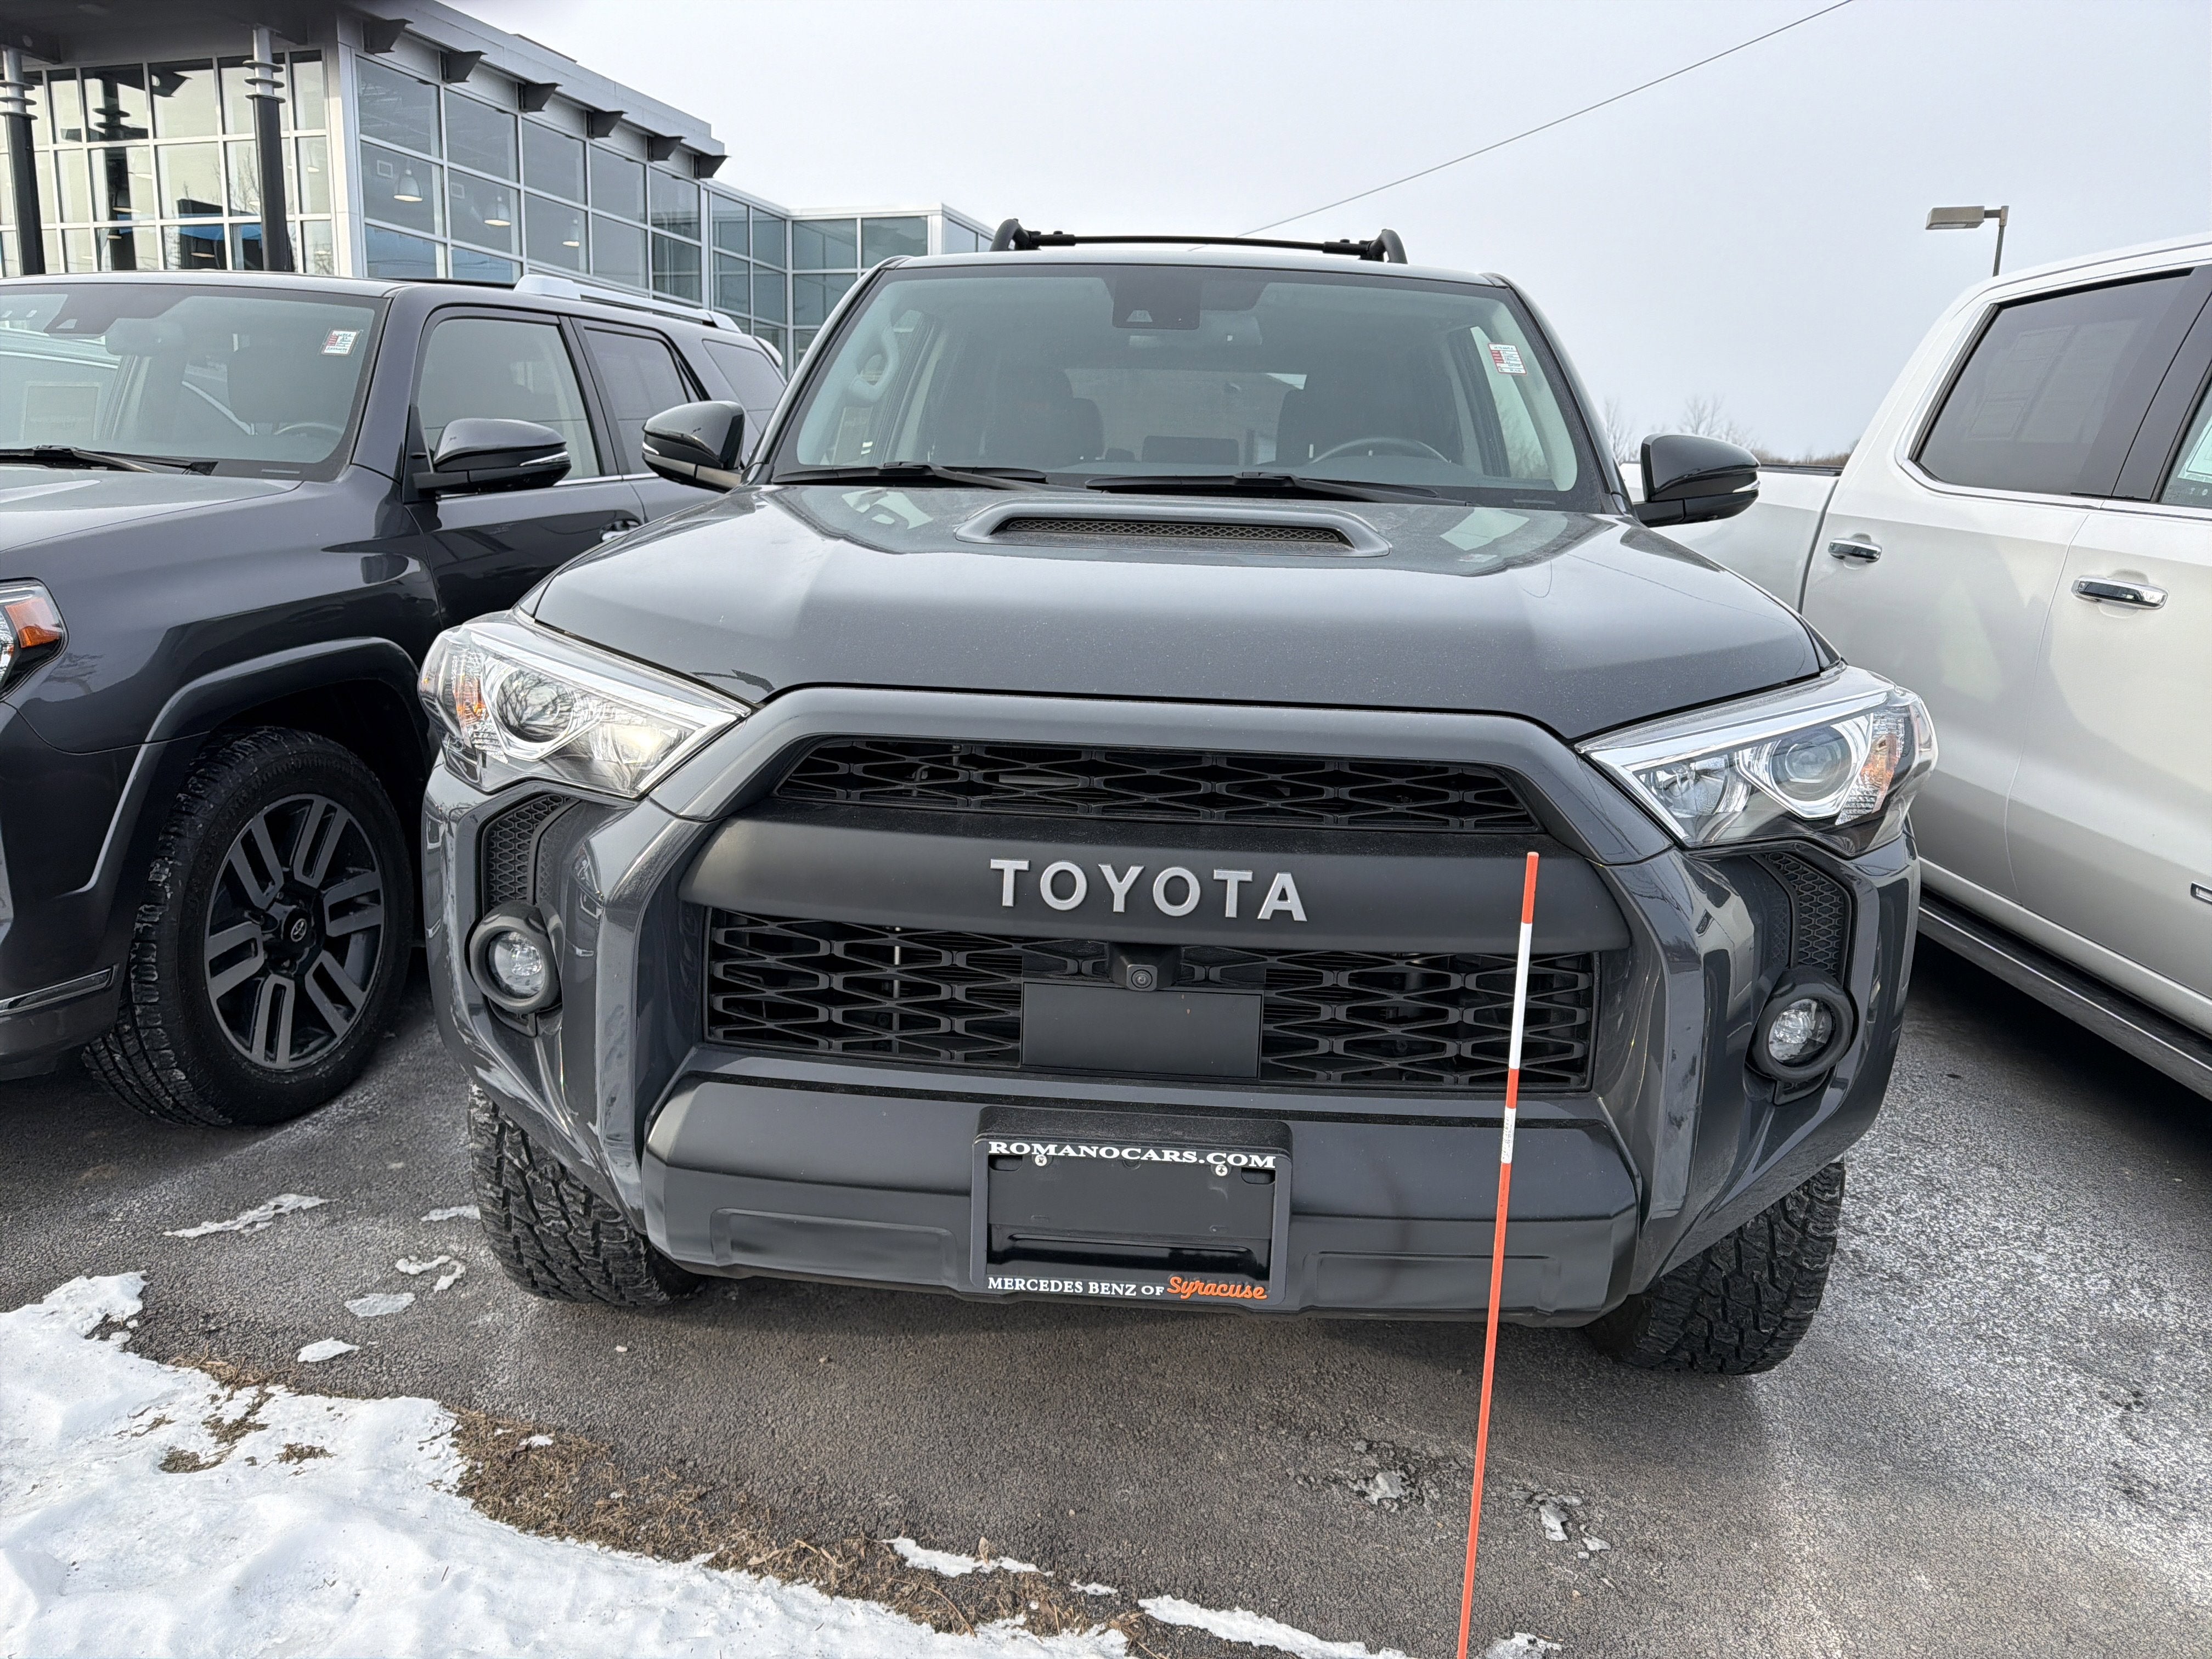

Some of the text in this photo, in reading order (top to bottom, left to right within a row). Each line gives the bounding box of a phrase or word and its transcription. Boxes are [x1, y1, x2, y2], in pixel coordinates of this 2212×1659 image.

[990, 858, 1308, 922] TOYOTA
[989, 1141, 1276, 1169] ROMANOCARS.COM
[988, 1276, 1268, 1300] MERCEDES BENZ OF Syracuse
